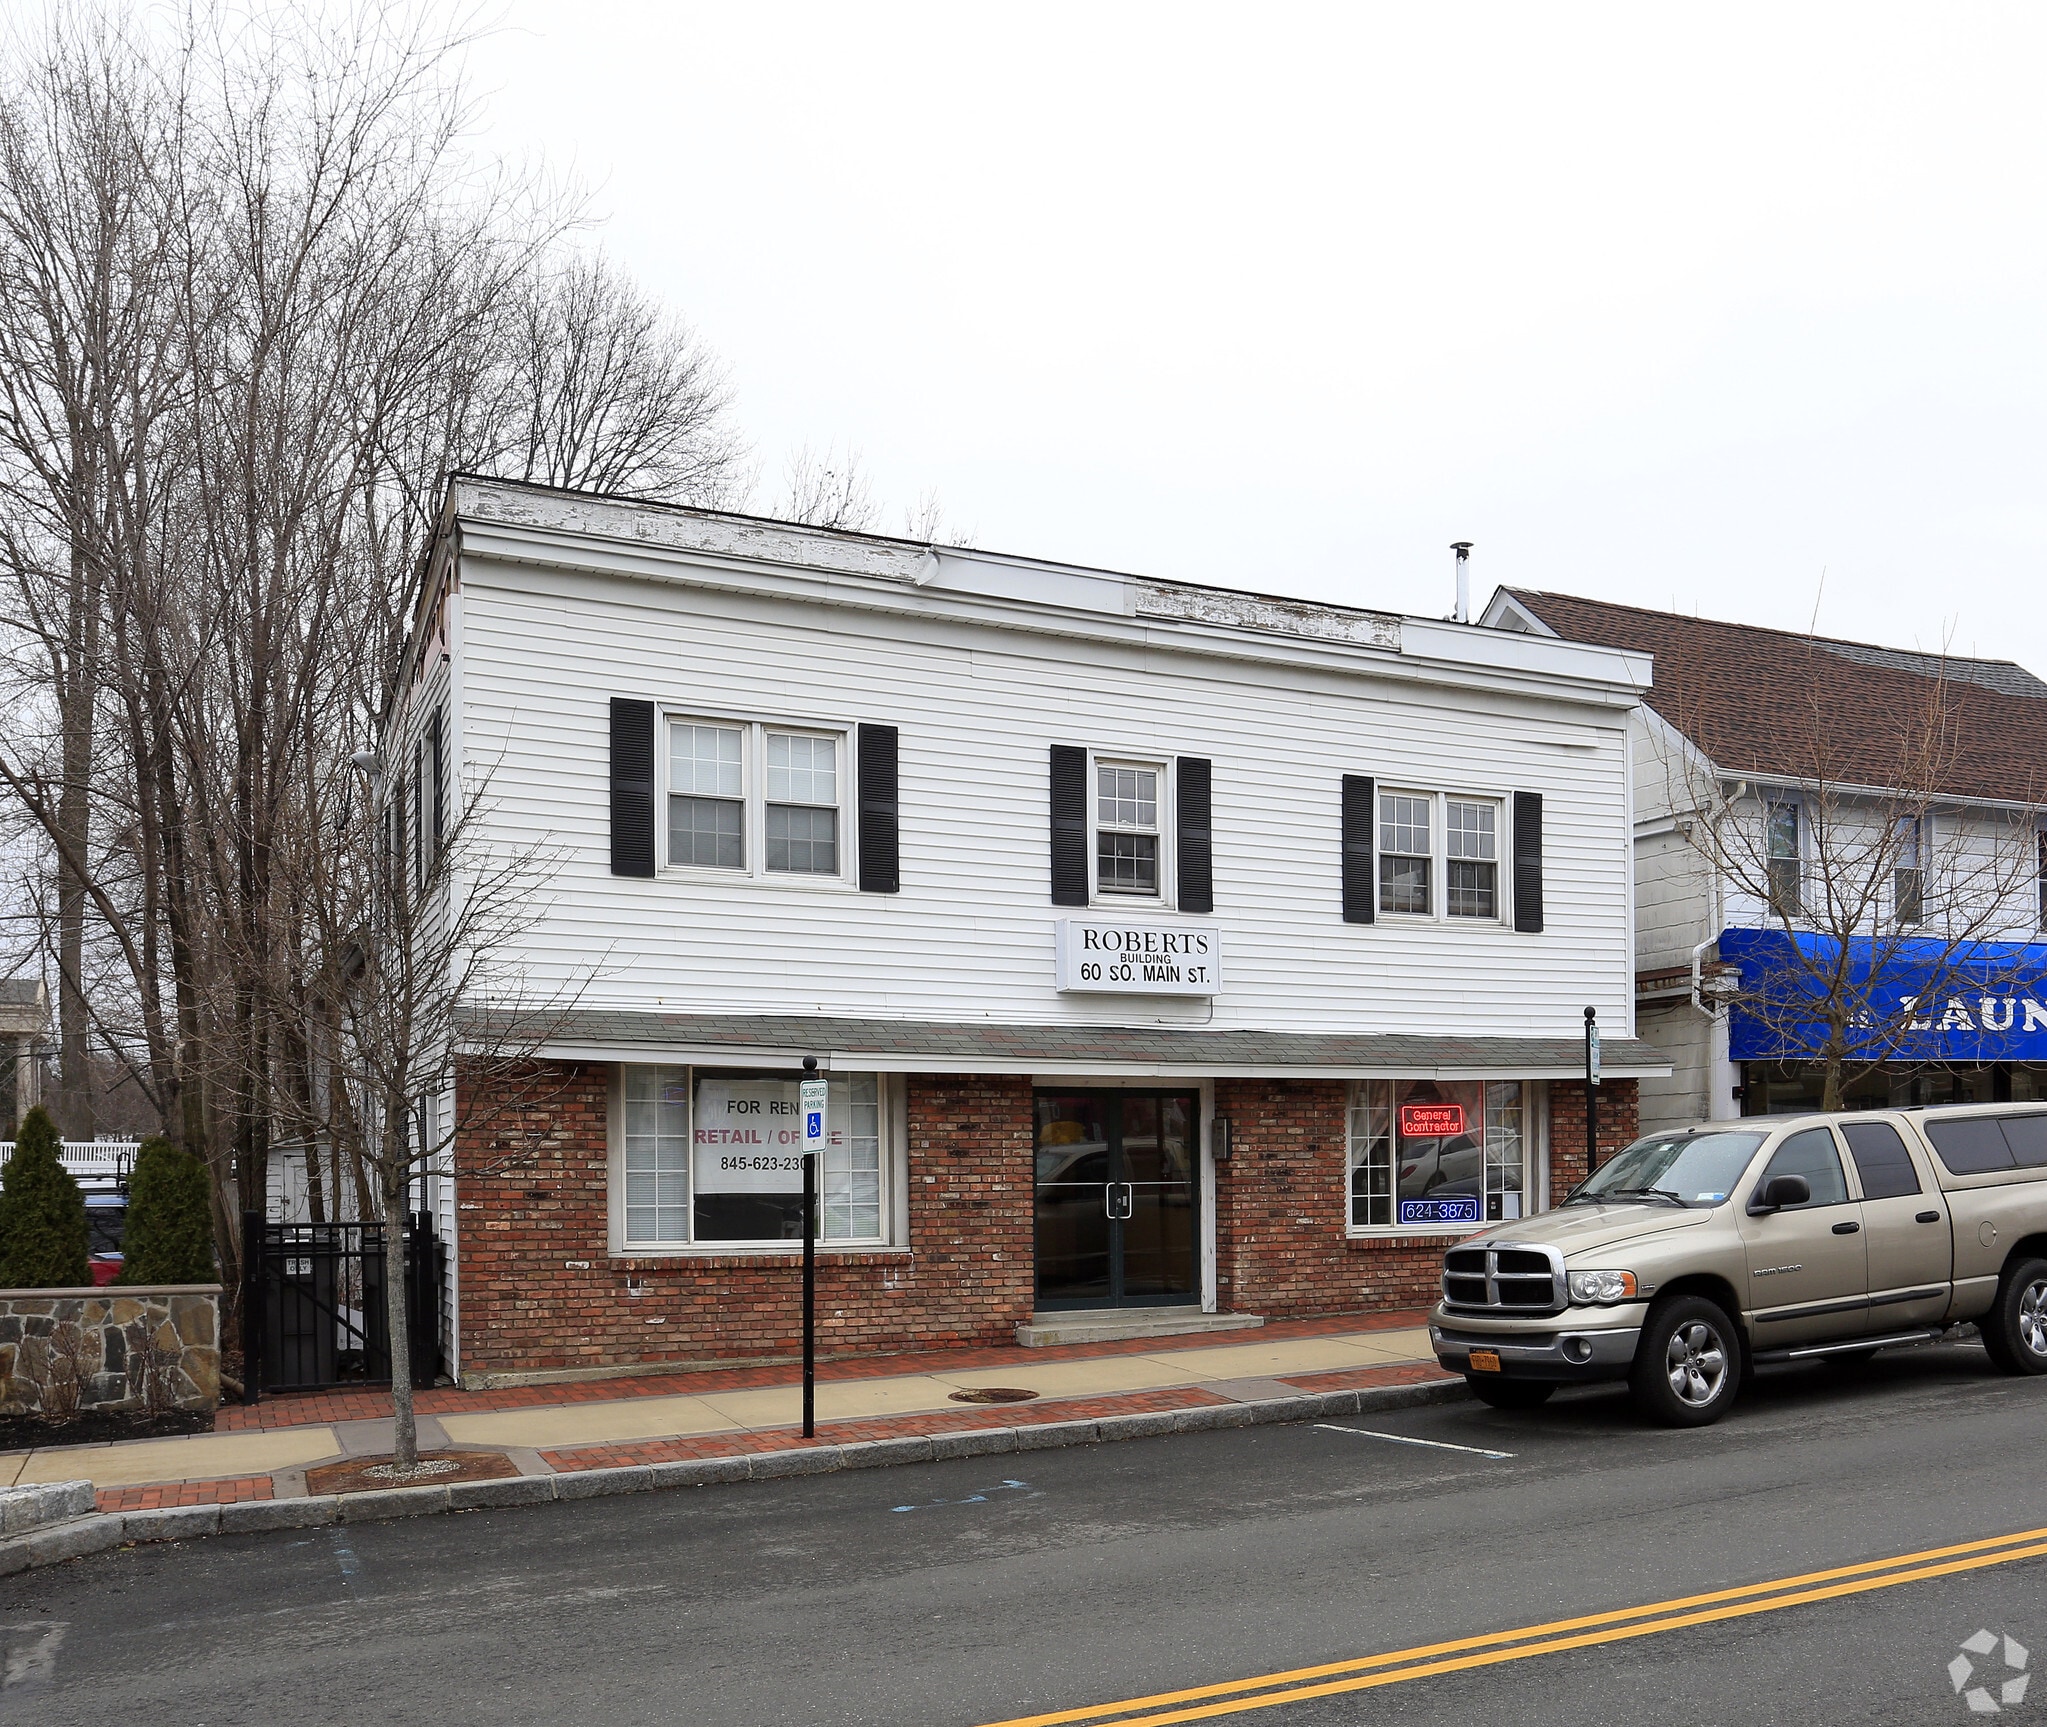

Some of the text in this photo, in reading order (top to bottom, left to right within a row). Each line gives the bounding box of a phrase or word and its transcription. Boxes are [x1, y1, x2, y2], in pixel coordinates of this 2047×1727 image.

[1082, 928, 1209, 955] ROBERTS
[1120, 953, 1172, 965] BUILDING
[1080, 962, 1210, 984] 60 SO. MAIN ST.
[802, 1087, 826, 1098] RESERVED
[727, 1100, 800, 1115] FOR REN
[804, 1099, 825, 1110] PARKING
[1413, 1110, 1451, 1121] General
[1405, 1121, 1460, 1132] Contractor
[694, 1129, 762, 1144] RETAIL
[778, 1130, 843, 1145] OFE
[720, 1156, 805, 1171] 845-623-230
[1406, 1203, 1473, 1219] 624-3875
[1753, 1264, 1803, 1278] RAM 1500
